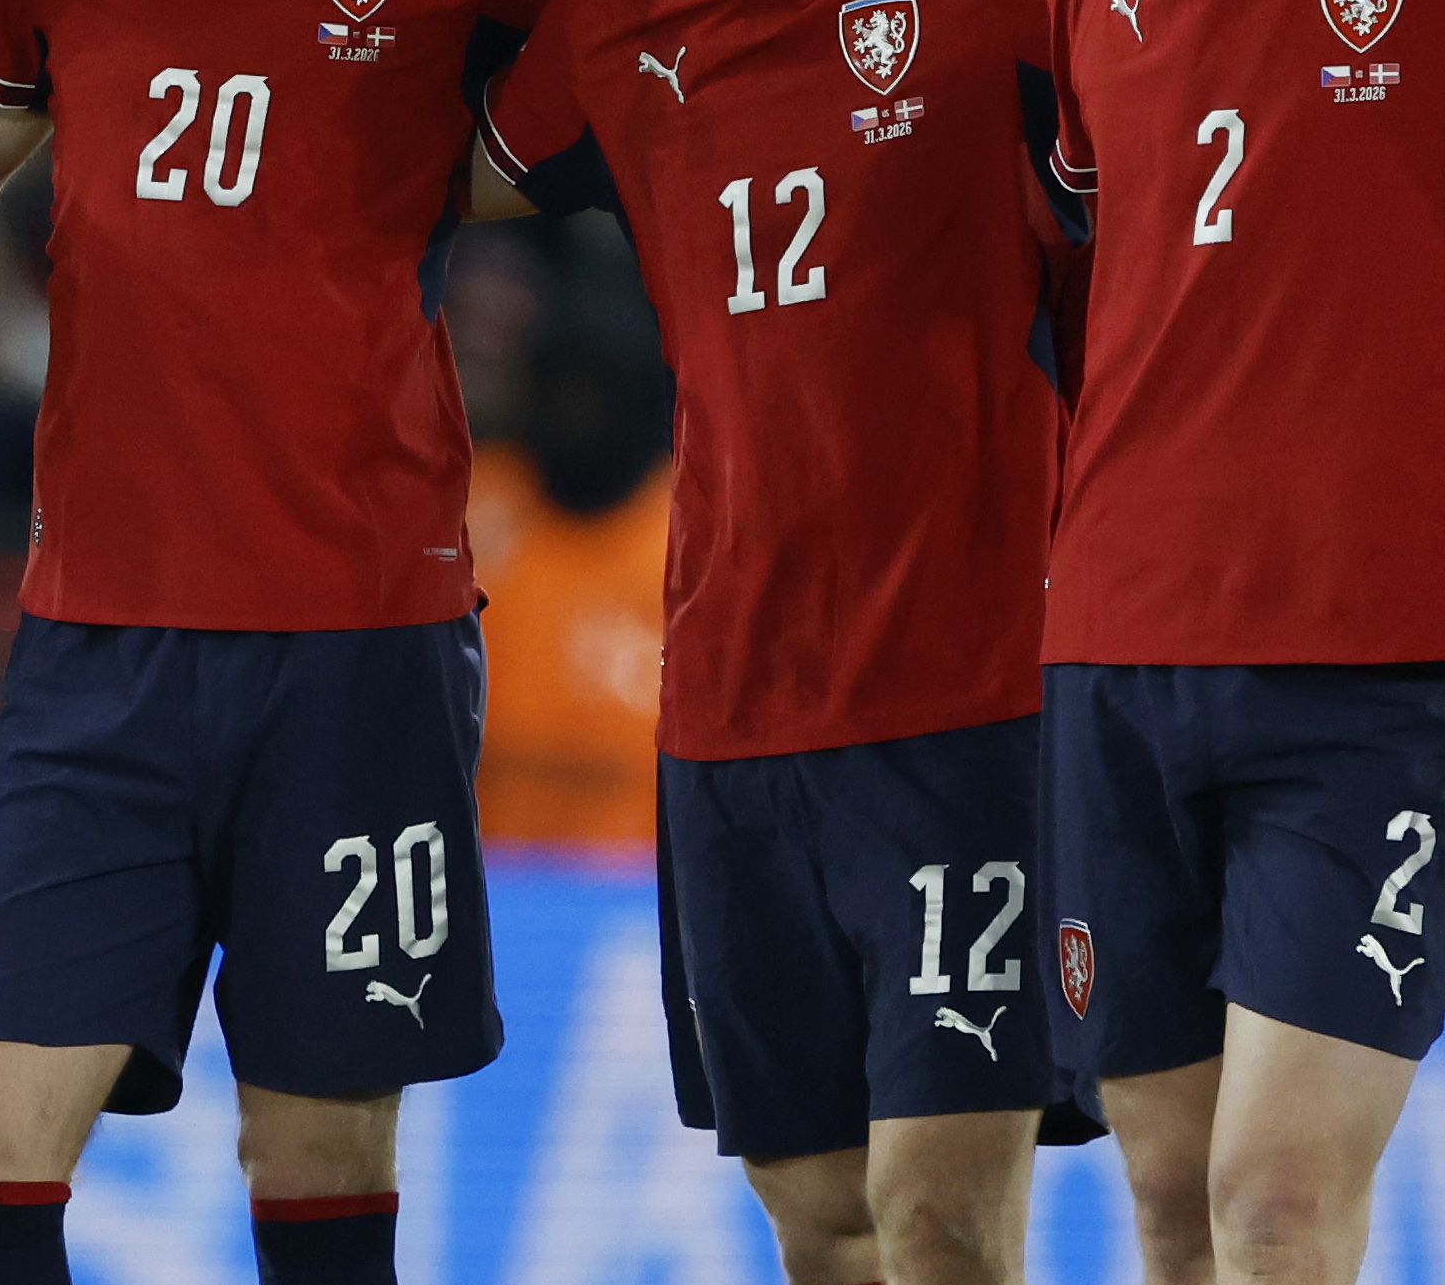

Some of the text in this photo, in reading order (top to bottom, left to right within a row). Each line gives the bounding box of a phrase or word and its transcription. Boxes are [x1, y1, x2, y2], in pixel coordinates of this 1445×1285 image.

[136, 68, 270, 206] 20
[864, 121, 912, 145] 31.3.2026
[1333, 86, 1386, 103] 31.3.2026
[719, 166, 826, 314] 12
[1193, 109, 1244, 246] 2
[324, 821, 447, 971] 20
[909, 862, 1025, 995] 12
[1371, 811, 1436, 934] 2
